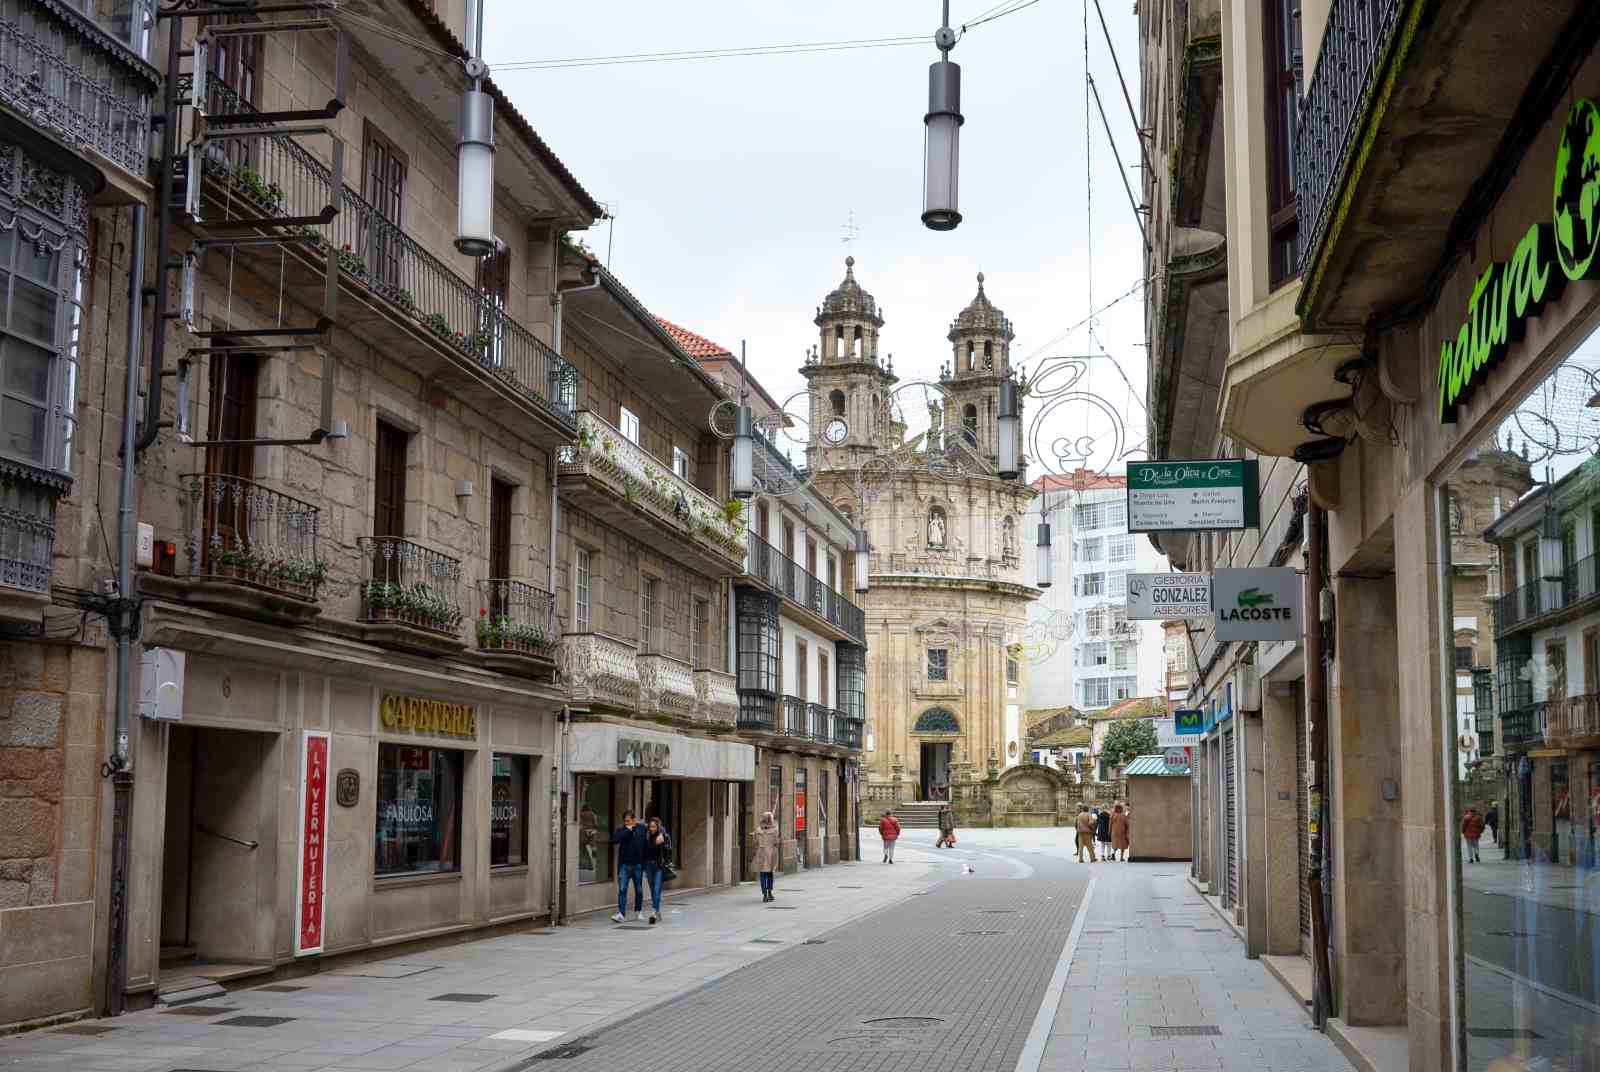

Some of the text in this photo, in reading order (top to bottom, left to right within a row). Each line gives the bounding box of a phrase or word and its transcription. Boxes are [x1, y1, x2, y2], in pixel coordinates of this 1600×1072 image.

[1438, 223, 1550, 422] natura
[1154, 576, 1204, 585] GESTORIA
[1153, 587, 1208, 603] GONZALEZ
[1153, 605, 1208, 615] ASESORES
[1220, 608, 1292, 621] LACOSTE
[381, 694, 478, 736] CAFETERIA
[386, 805, 433, 822] FABULOSA
[307, 751, 321, 934] LA VERMUTERIA
